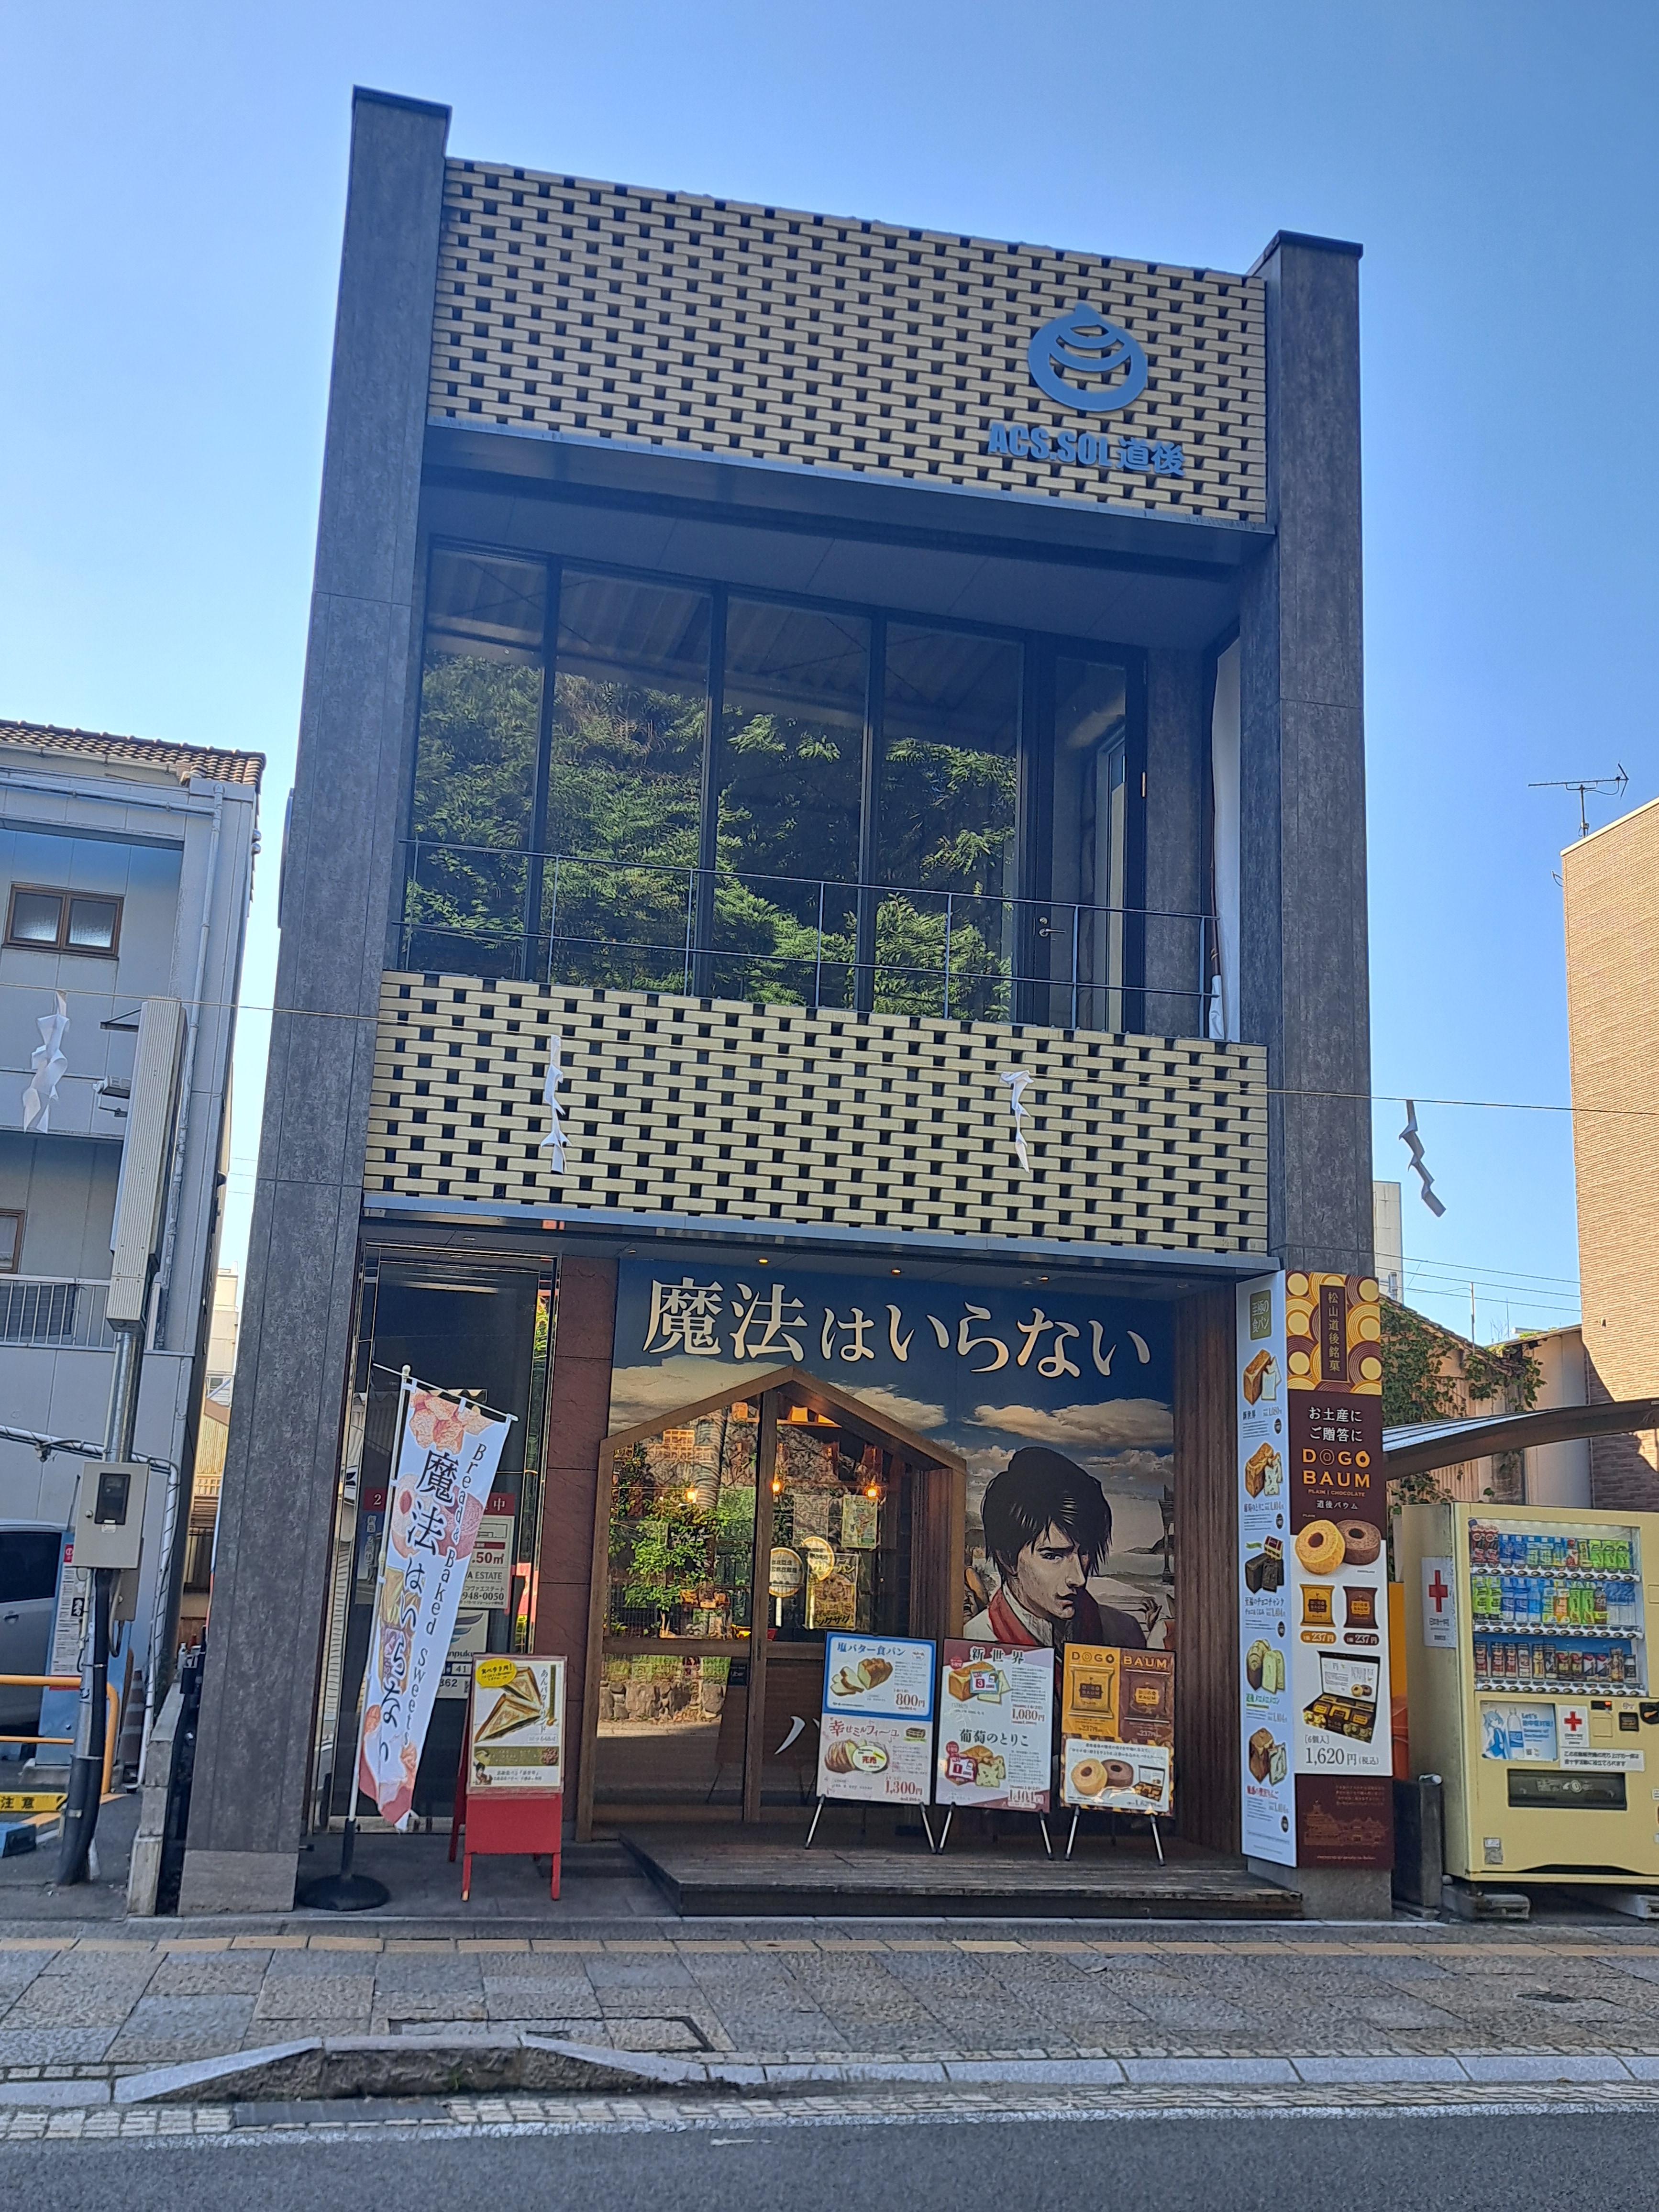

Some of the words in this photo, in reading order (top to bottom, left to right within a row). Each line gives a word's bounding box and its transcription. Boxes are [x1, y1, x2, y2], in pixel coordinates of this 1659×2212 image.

[642, 1276, 1151, 1378] 魔法はいらない
[1252, 1317, 1269, 1334] 食パン
[1327, 1292, 1341, 1372] 松山道後銘菓
[1308, 1406, 1362, 1423] お土産に
[1310, 1426, 1363, 1443] ご贈答に
[1302, 1448, 1371, 1468] DOGO
[1303, 1470, 1370, 1488] BAUM
[1316, 1499, 1359, 1510] 道後バウム
[475, 1571, 503, 1580] ESTATE
[426, 1548, 456, 1636] Baked
[837, 1642, 907, 1656] 塩バター食パン
[970, 1647, 1025, 1665] 新世界
[1071, 1651, 1115, 1664] DOGO
[1124, 1656, 1168, 1669] BAUM
[404, 1647, 428, 1747] Sweets
[829, 1719, 900, 1737] 幸せミルフィーユ
[960, 1728, 1029, 1747] 葡萄のとりこ
[0, 1796, 35, 1809] 注意
